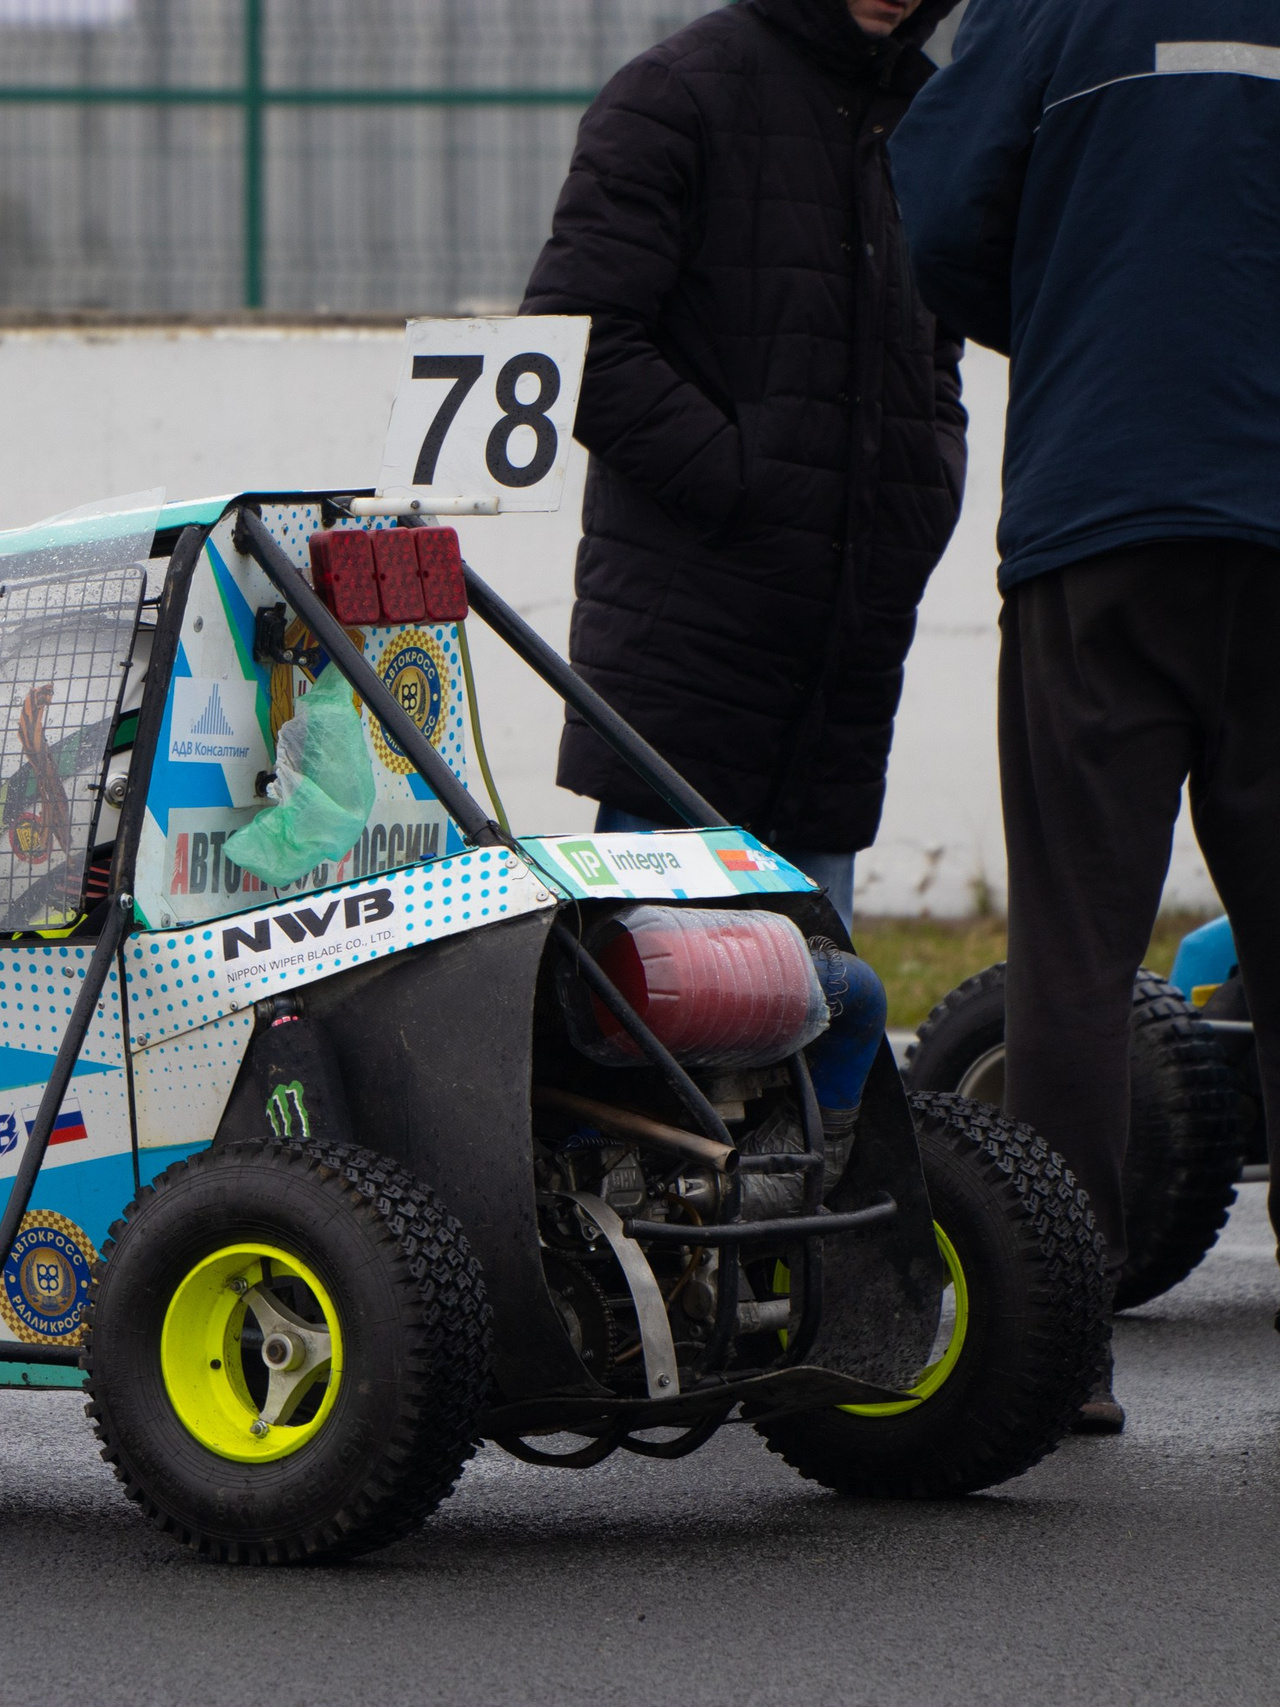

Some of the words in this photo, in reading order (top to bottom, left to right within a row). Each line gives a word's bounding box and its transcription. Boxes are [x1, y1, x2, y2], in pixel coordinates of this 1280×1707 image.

[412, 352, 561, 488] 78
[385, 651, 436, 688] АВТОКРОСС
[172, 741, 193, 758] АДВ
[195, 742, 250, 758] Консалтинг
[607, 849, 682, 876] integra
[222, 888, 395, 961] NWB
[227, 963, 267, 983] NIPPON
[269, 955, 305, 971] WIPER
[307, 945, 343, 962] BLADE
[345, 938, 367, 951] CO.,
[370, 930, 395, 944] LTD.
[10, 1230, 83, 1266] АВТОКРОСС
